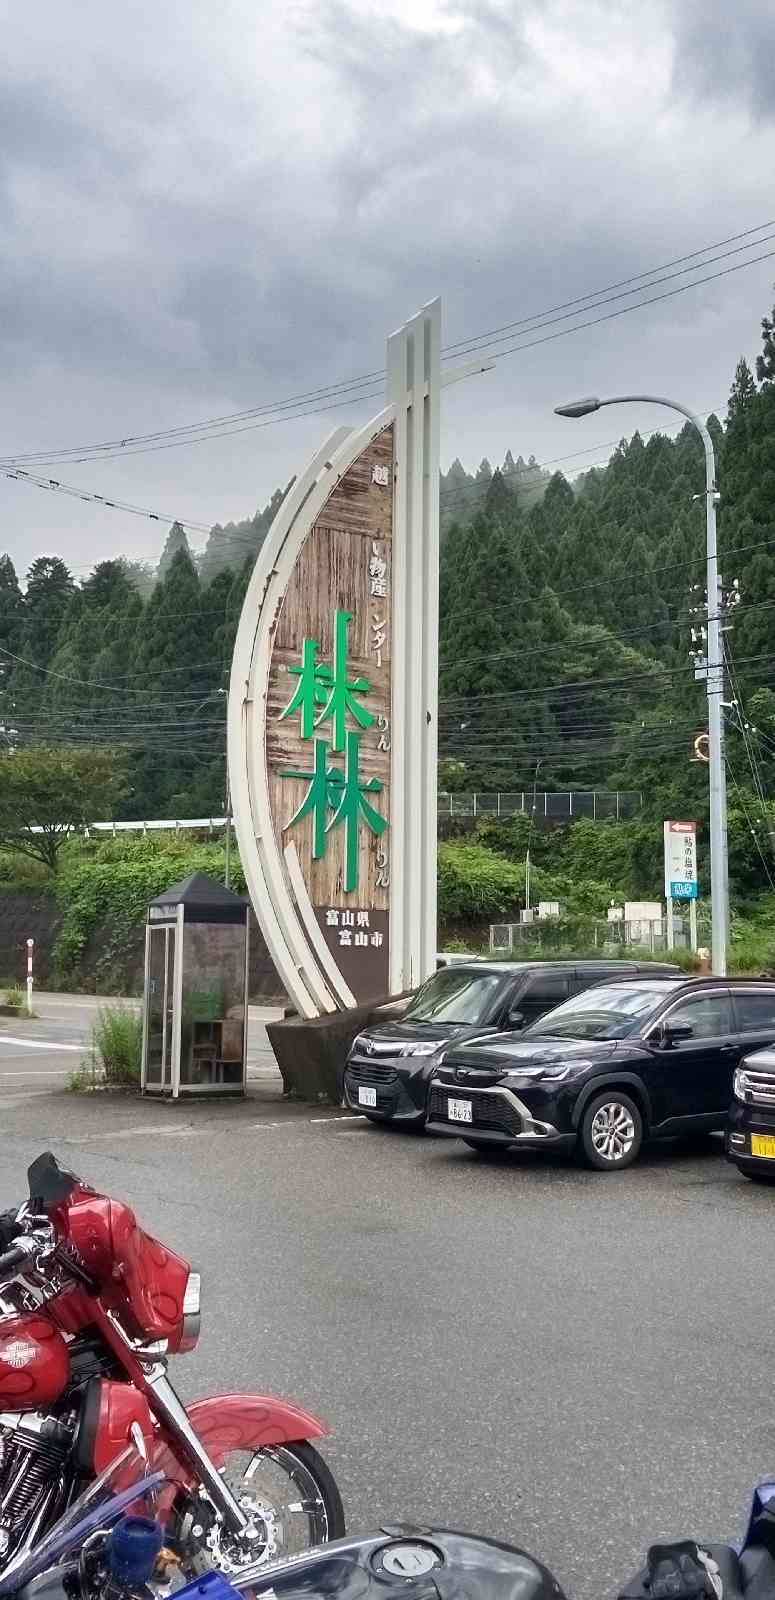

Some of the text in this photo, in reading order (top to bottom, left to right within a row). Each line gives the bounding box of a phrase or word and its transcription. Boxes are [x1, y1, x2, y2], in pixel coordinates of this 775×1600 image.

[374, 714, 391, 751] りん
[373, 850, 390, 888] りん
[325, 909, 370, 928] 富山県
[338, 929, 384, 948] 富山市
